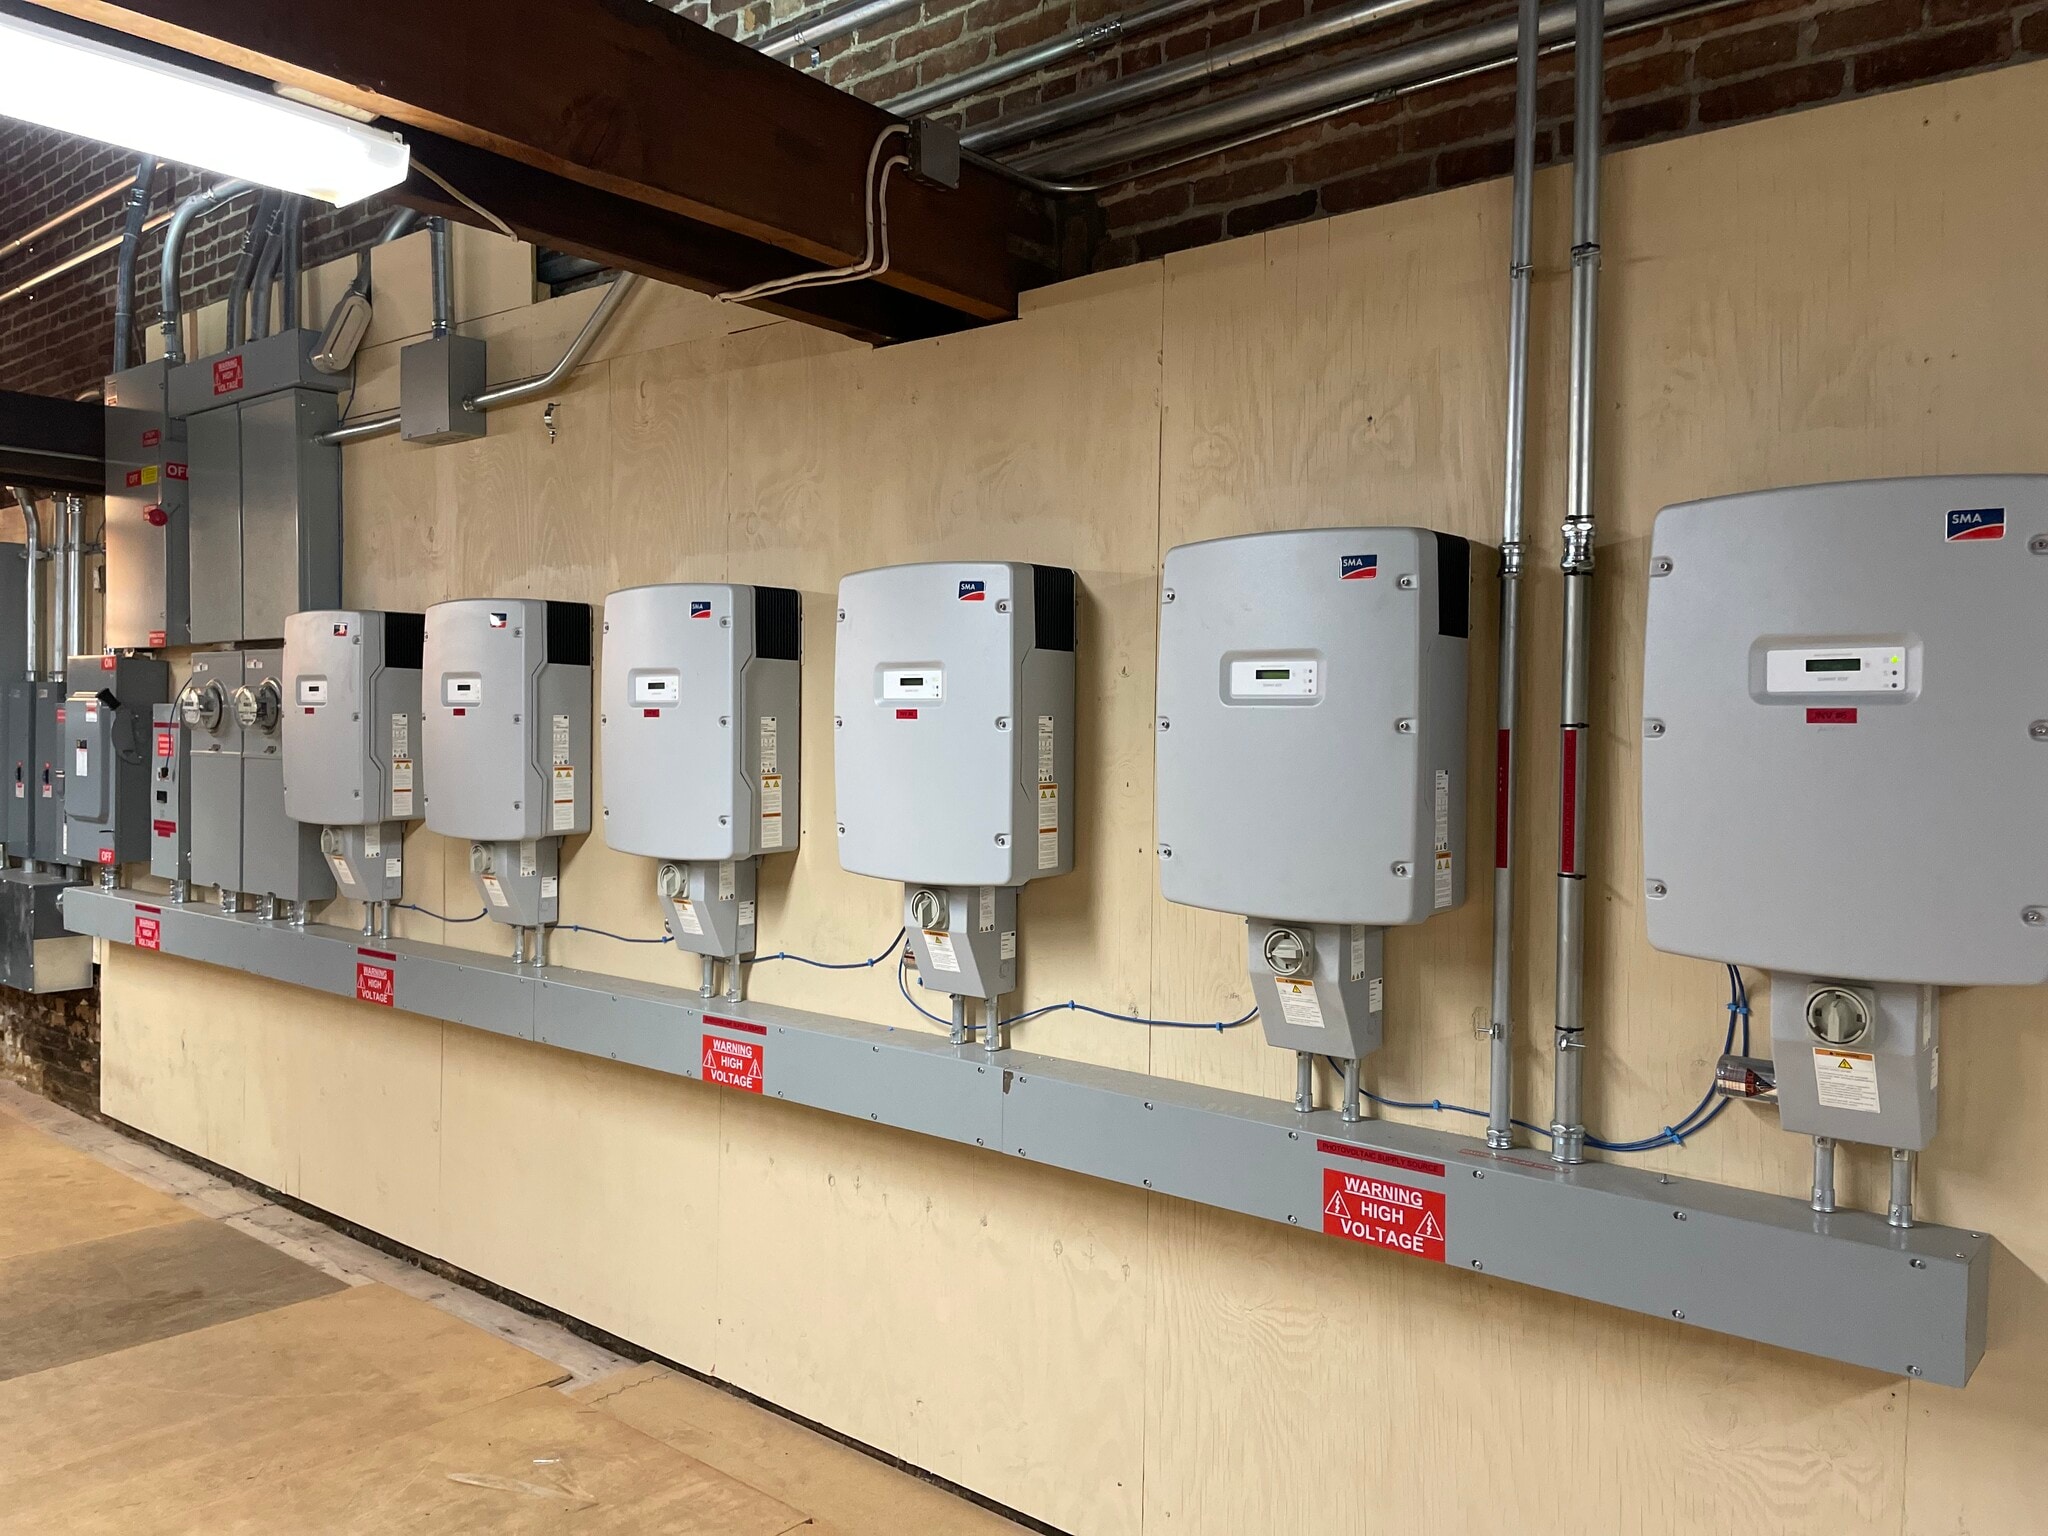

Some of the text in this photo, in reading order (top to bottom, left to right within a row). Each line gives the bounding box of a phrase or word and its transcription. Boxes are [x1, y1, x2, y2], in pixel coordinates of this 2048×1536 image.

[1952, 513, 1982, 524] SMA
[1342, 558, 1363, 567] SMA
[960, 583, 976, 591] SMA
[104, 657, 113, 668] ON
[101, 850, 112, 862] OFF
[363, 965, 387, 979] WARNING
[367, 978, 382, 990] HIGH
[361, 989, 388, 1004] VOLTAGE
[713, 1039, 753, 1057] WARNING
[721, 1055, 743, 1071] HIGH
[711, 1069, 753, 1089] VOLTAGE
[1322, 1143, 1439, 1174] PHOTOVOLTAIC SUPPLY SOURCE
[1344, 1176, 1423, 1207] WARNING
[1361, 1201, 1404, 1225] HIGH
[1341, 1218, 1425, 1253] VOLTAGE
